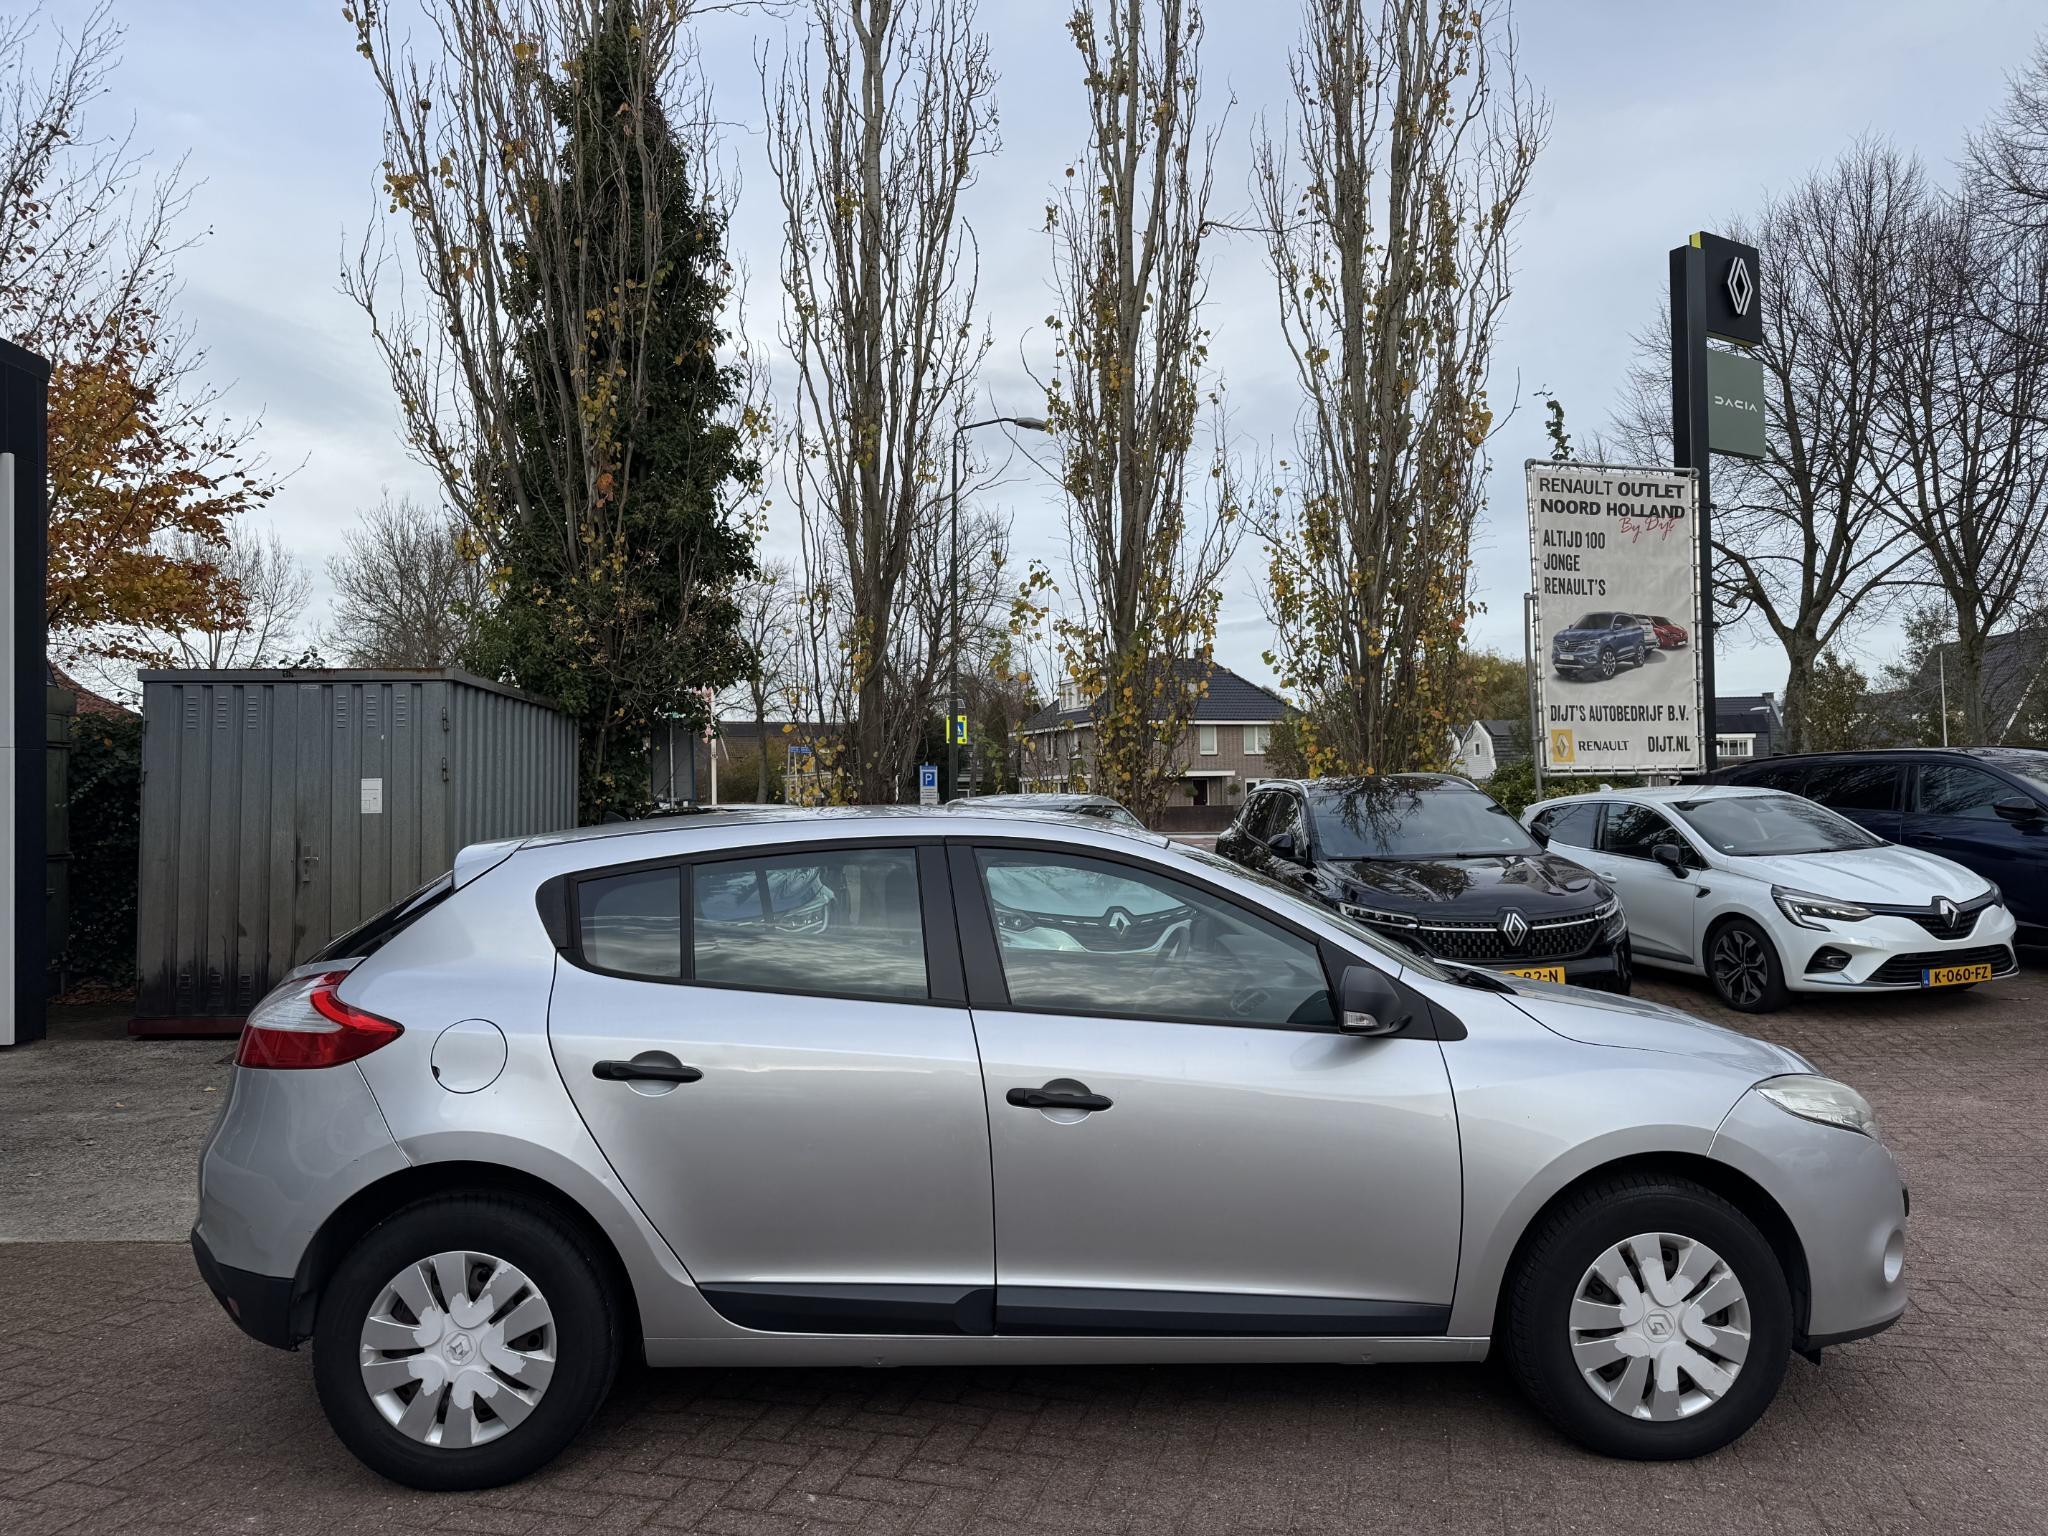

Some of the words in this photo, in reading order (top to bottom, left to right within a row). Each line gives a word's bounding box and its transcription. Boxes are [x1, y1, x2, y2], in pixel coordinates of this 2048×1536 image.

[1714, 395, 1758, 412] DACIA
[1539, 477, 1613, 495] RENAULT
[1617, 481, 1685, 499] OUTLET
[1540, 498, 1601, 516] NOORD
[1606, 502, 1686, 519] HOLLAND
[1543, 529, 1583, 548] ALTIJD
[1586, 531, 1606, 550] 100
[1618, 517, 1642, 544] By
[1543, 552, 1580, 572] JONGE
[1544, 577, 1606, 596] RENAULT'S
[1550, 704, 1586, 722] DIJT'S
[1589, 705, 1664, 722] AUTOBEDRIJF
[1667, 705, 1689, 721] B.V.
[1578, 740, 1630, 752] RENAULT
[1647, 735, 1691, 752] DIJT.NL
[925, 772, 933, 785] P
[1934, 966, 1988, 983] K-060-FZ
